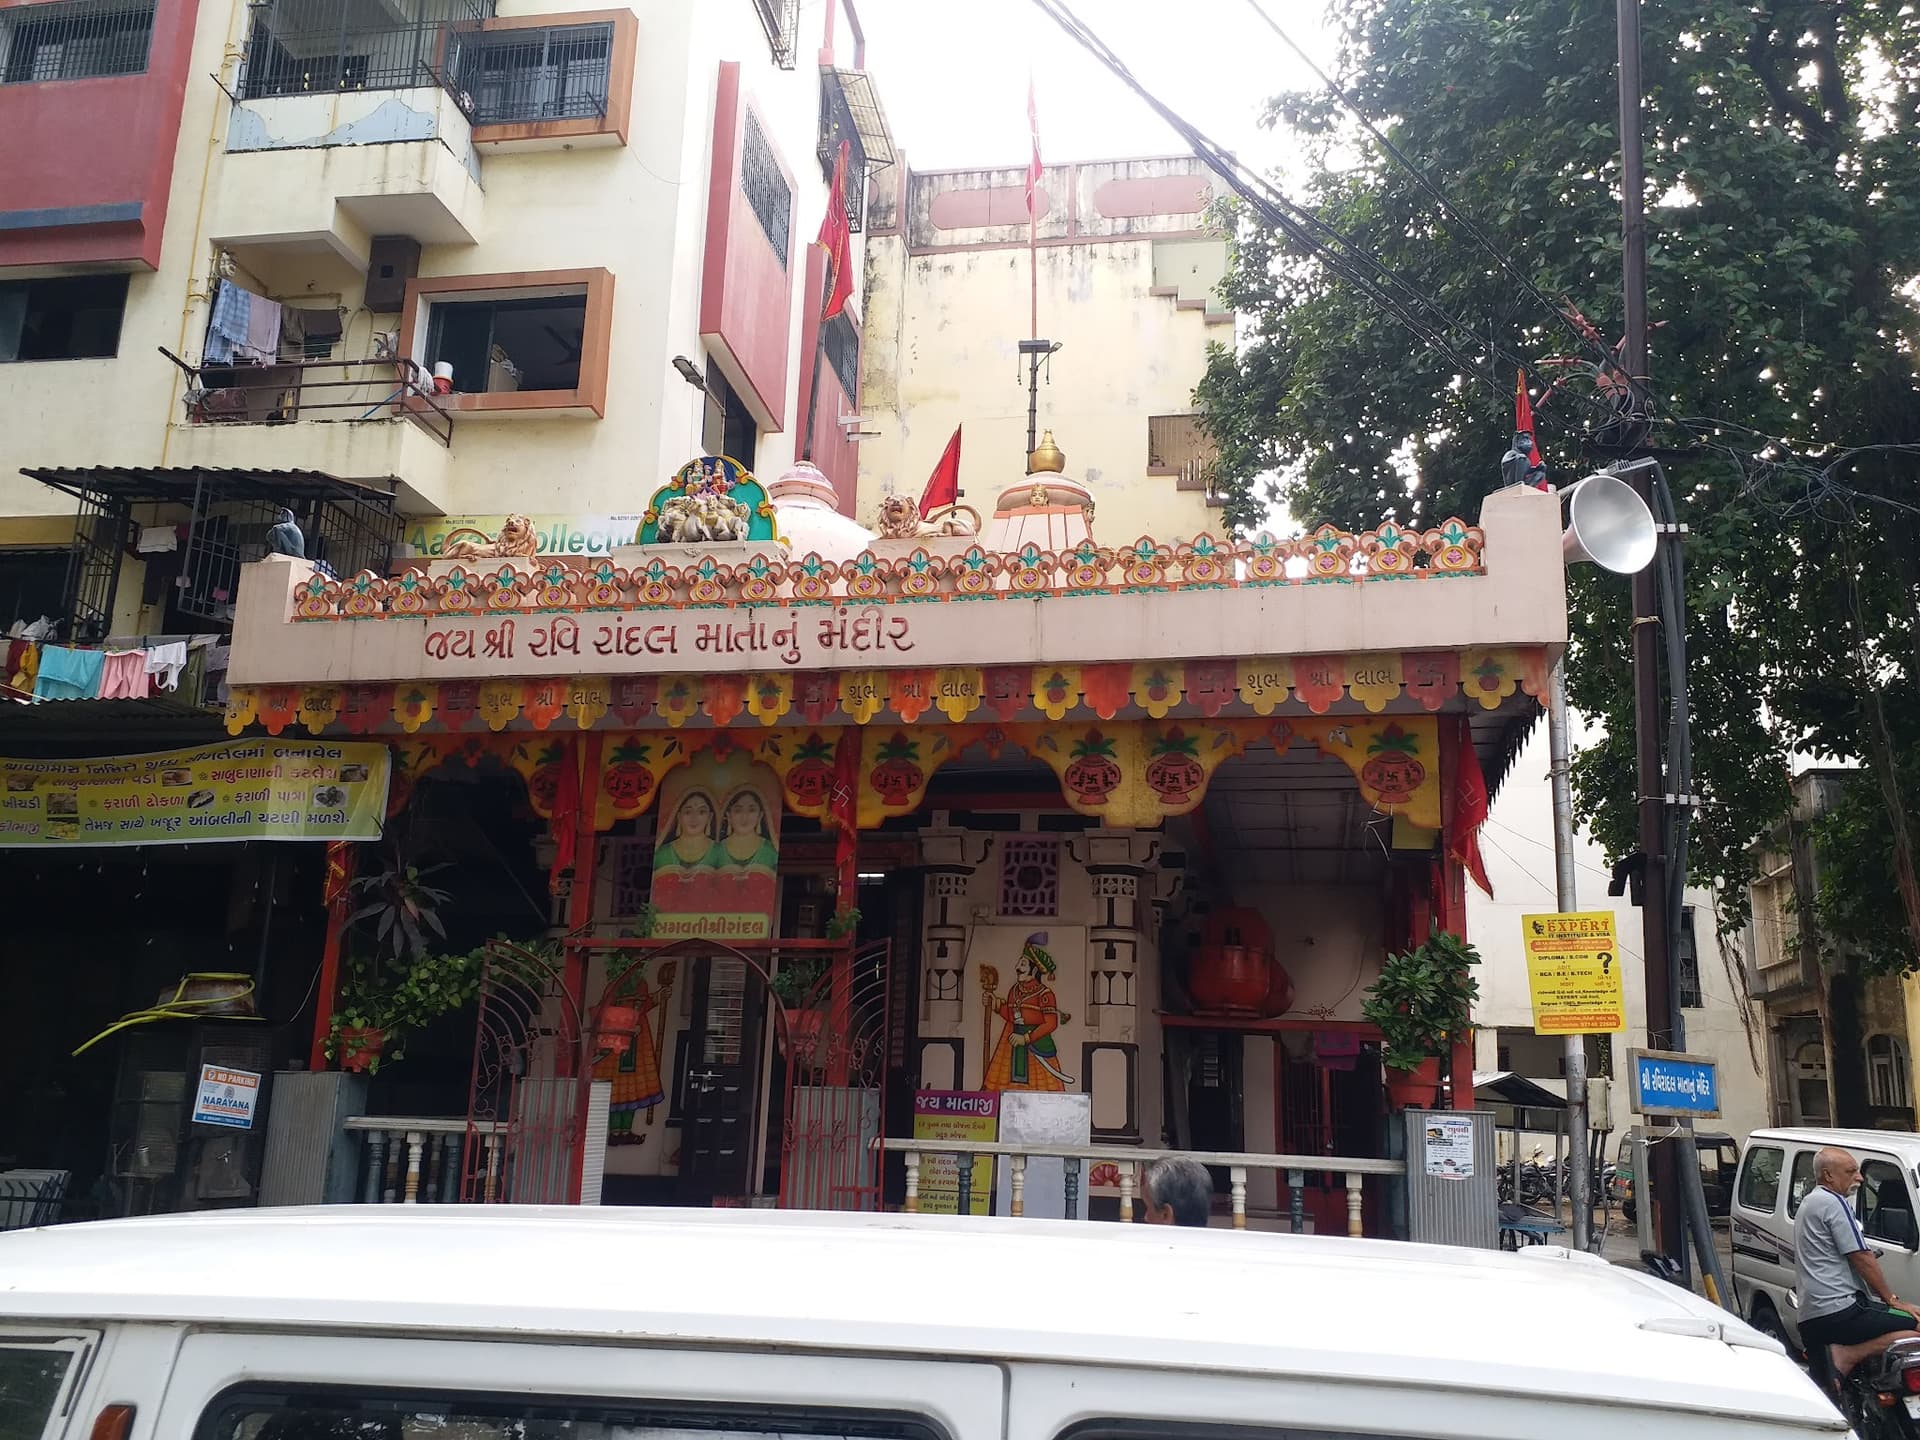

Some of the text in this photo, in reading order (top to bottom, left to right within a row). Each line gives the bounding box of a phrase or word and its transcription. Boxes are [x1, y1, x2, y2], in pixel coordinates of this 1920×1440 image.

[425, 606, 916, 664] જય શ્રી રવિ રાંદલ માતાનું મંદીર
[1354, 669, 1393, 686] લાભ
[942, 681, 975, 698] લાભ
[1547, 919, 1609, 932] EXPERT
[202, 1096, 250, 1110] NARAYANA
[916, 1095, 993, 1116] જય માતાજી
